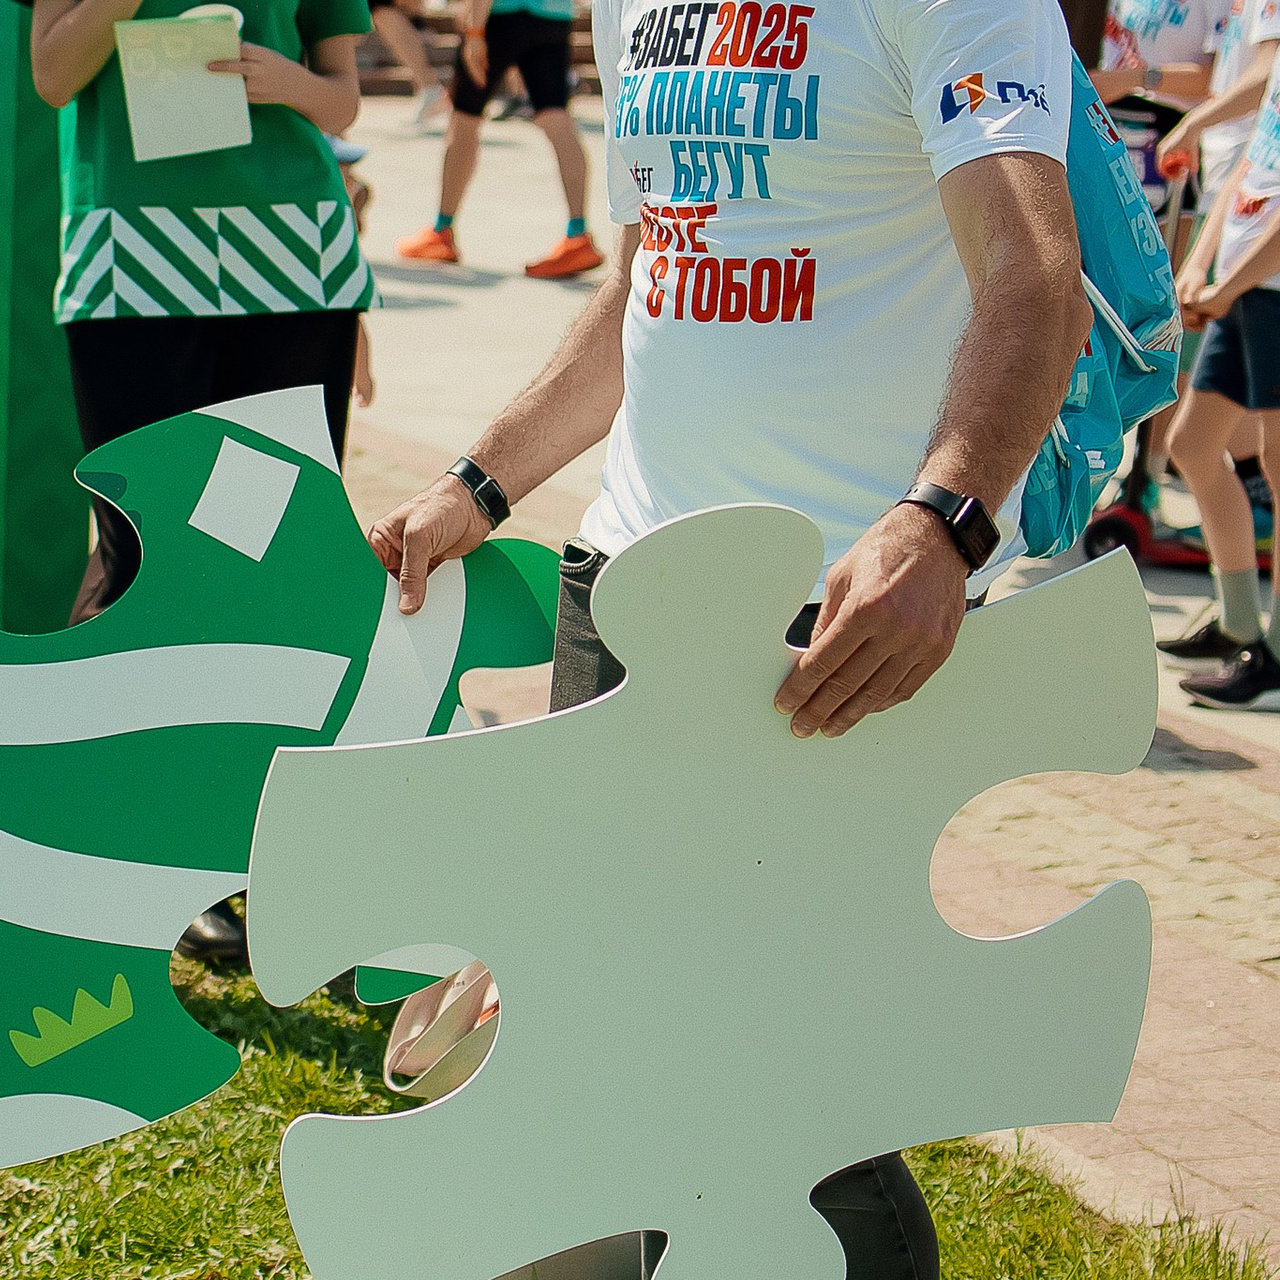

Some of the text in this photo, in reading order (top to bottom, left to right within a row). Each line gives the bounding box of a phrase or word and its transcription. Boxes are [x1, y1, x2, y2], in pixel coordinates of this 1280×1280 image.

[646, 71, 820, 139] ПЛАНЕТЫ
[670, 141, 772, 202] БЕГУТ
[646, 248, 816, 323] С ТОБОЙ
